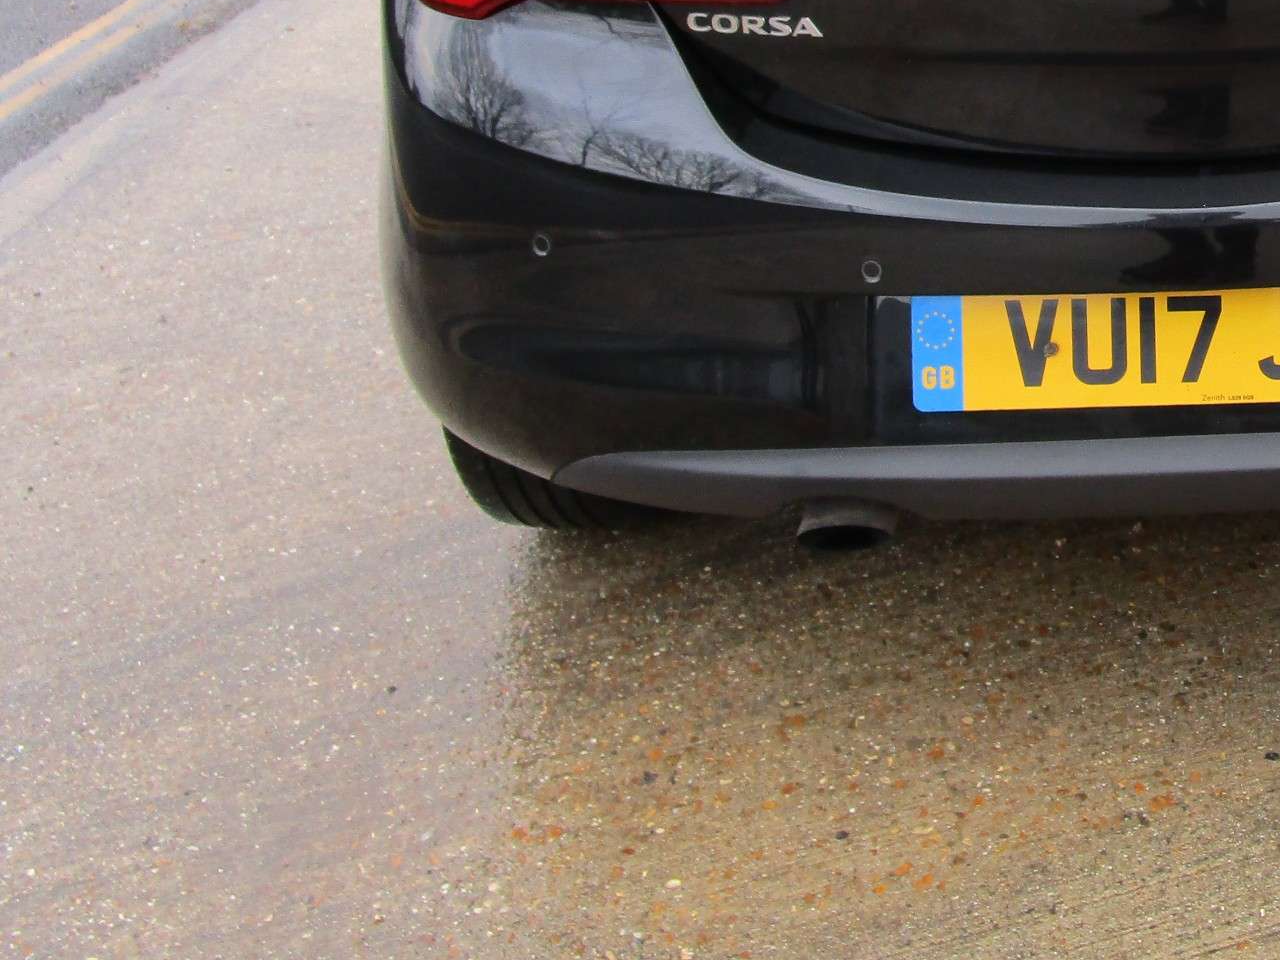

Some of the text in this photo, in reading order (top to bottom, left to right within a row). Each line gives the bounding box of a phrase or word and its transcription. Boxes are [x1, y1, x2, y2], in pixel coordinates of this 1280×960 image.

[686, 12, 824, 38] CORSA
[1004, 295, 1223, 387] VU17
[921, 365, 956, 390] GB
